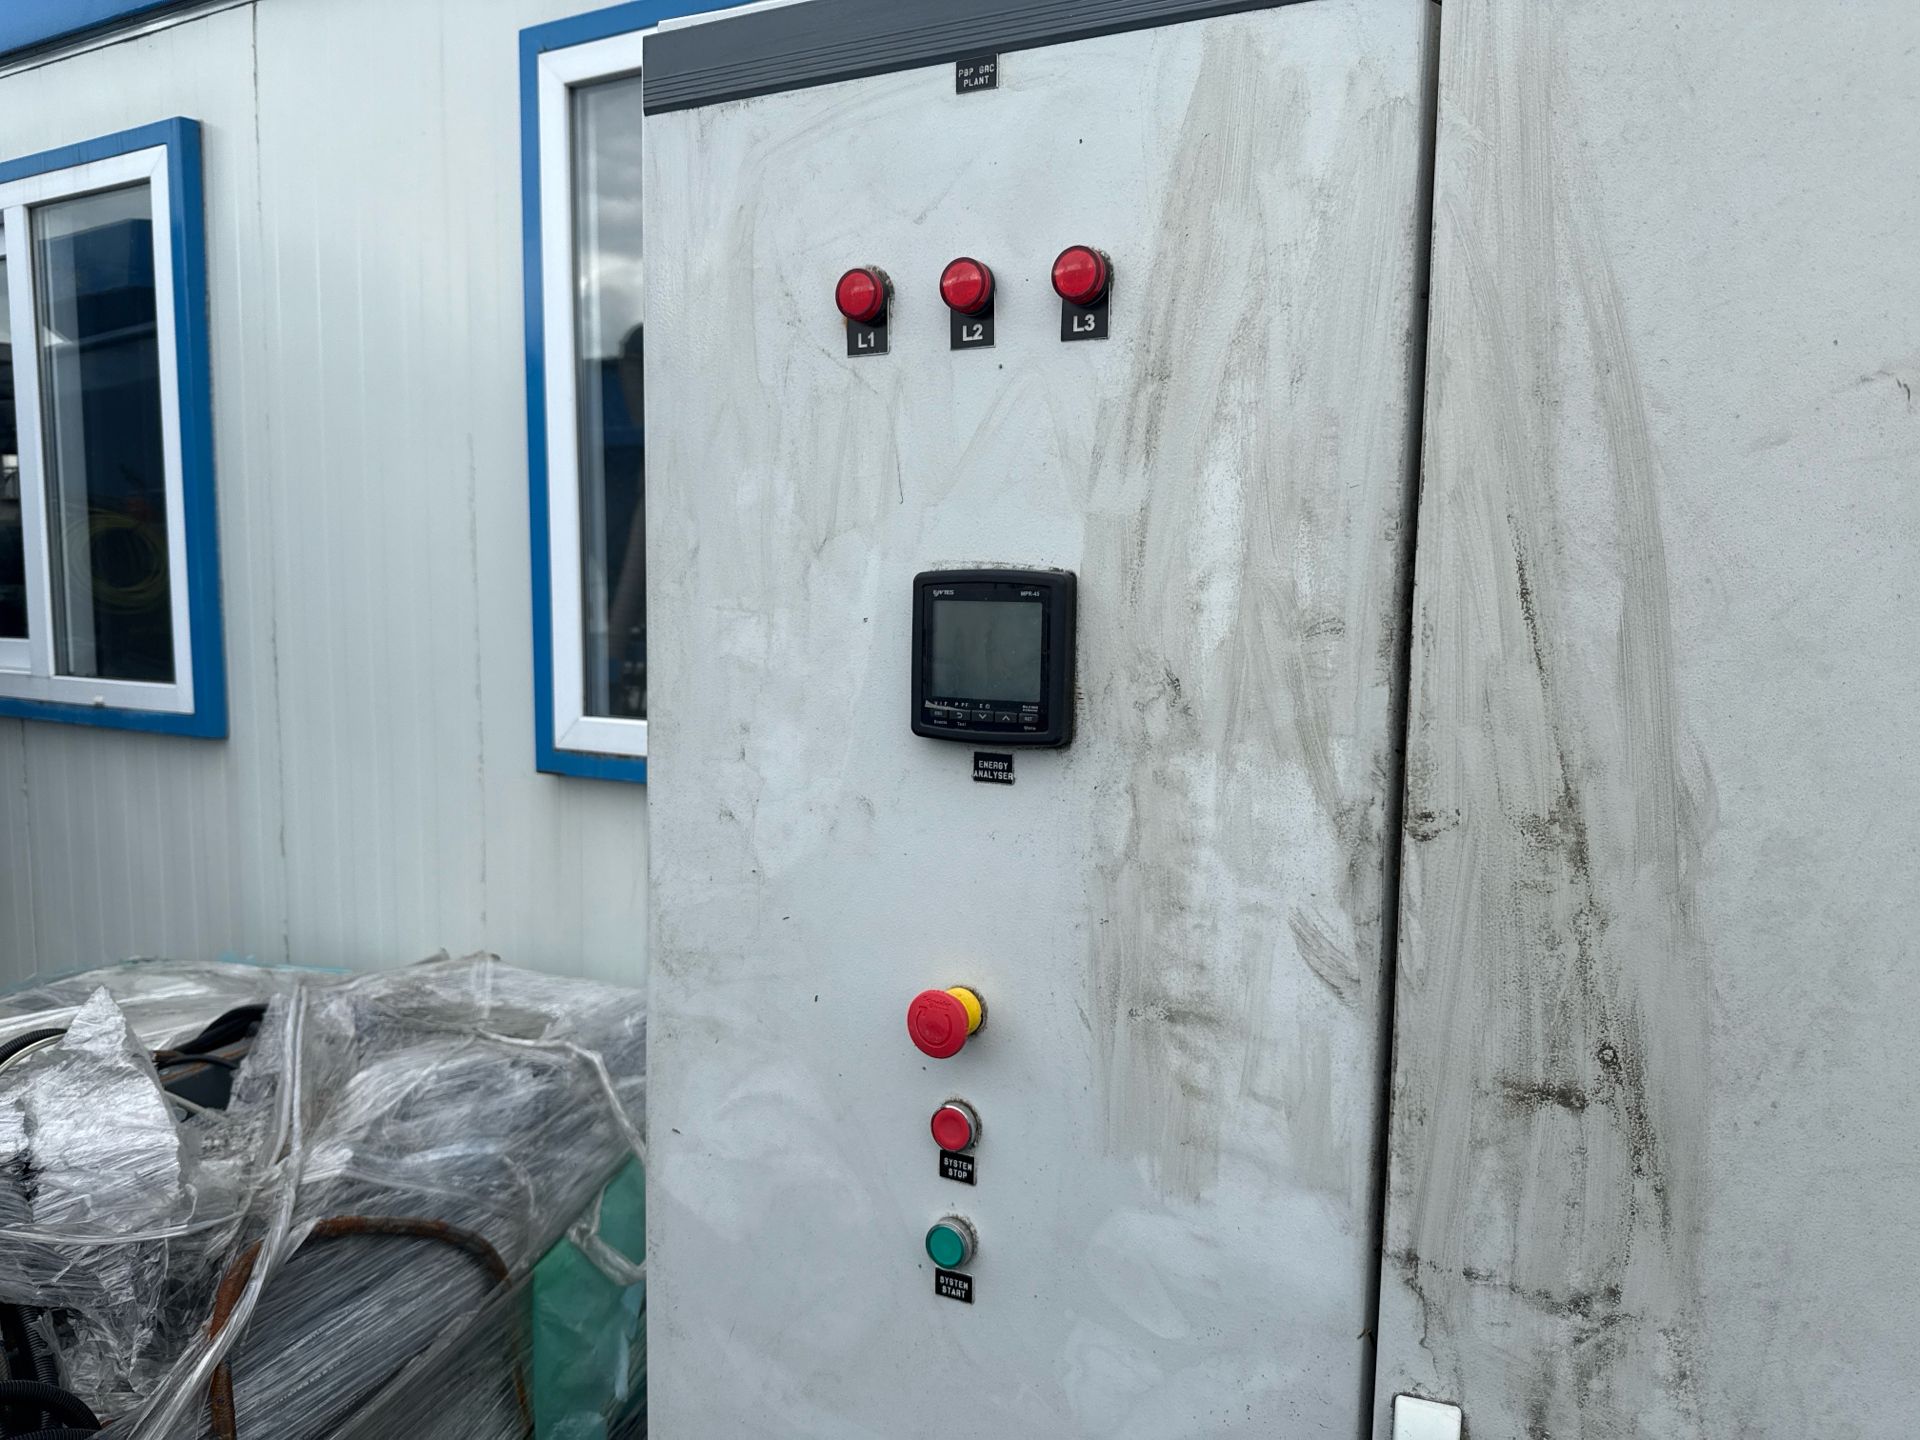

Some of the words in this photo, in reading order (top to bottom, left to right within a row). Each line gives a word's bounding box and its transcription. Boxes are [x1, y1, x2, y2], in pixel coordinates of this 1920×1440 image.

[963, 75, 990, 88] PLANT
[1072, 314, 1095, 332] L3
[857, 332, 875, 348] L1
[962, 324, 983, 342] L2
[978, 760, 1009, 770] ENERGY
[973, 770, 1014, 780] ANALYSER
[943, 1157, 973, 1171] SYSTEM
[948, 1168, 968, 1179] STOP
[940, 1275, 969, 1291] SYSTEM
[942, 1285, 966, 1299] START
